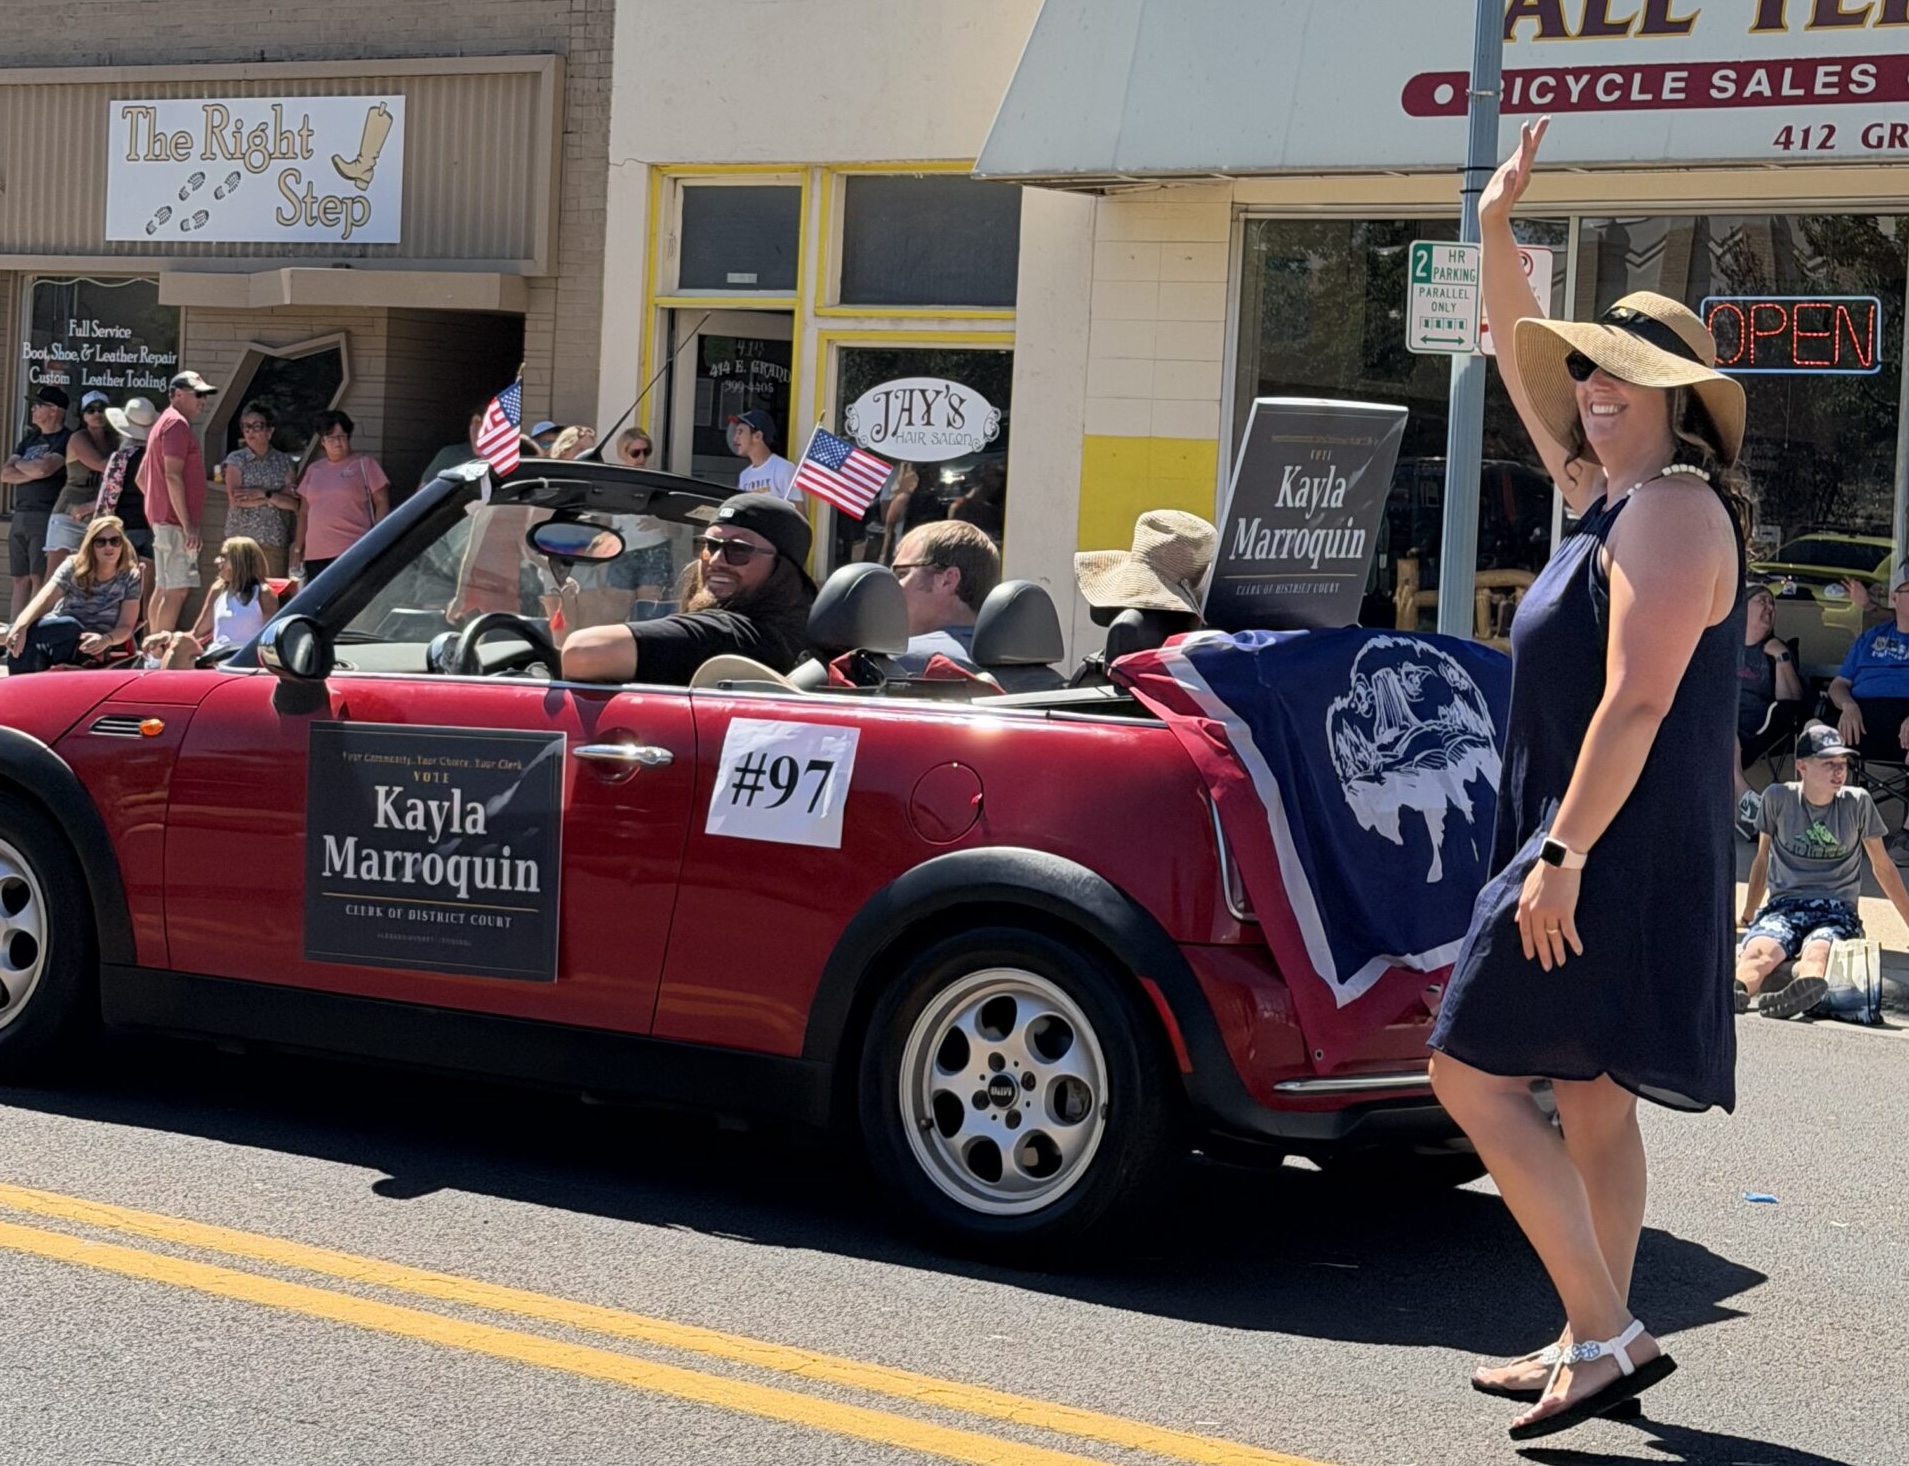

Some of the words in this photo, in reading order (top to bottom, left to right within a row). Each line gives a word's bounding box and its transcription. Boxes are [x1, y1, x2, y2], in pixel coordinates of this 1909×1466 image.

[1499, 70, 1689, 105] ICYCLE
[1709, 63, 1878, 99] SALES
[122, 105, 194, 162] The
[200, 103, 314, 174] Right
[1772, 123, 1837, 150] 412
[276, 167, 371, 240] Step
[1415, 250, 1429, 277] 2
[1448, 250, 1466, 264] HR
[1432, 267, 1476, 282] PARKING
[1419, 287, 1470, 299] PARALLEL
[1431, 302, 1457, 313] ONLY
[69, 319, 91, 337] Full
[91, 319, 132, 338] Service
[1707, 303, 1875, 367] OPEN
[50, 342, 80, 363] Shoe,
[81, 343, 95, 361] &
[95, 344, 138, 363] Leather
[139, 345, 177, 368] Repair
[709, 360, 731, 378] 414
[735, 359, 747, 373] E.
[29, 366, 70, 384] Custom
[81, 368, 125, 387] Leather
[126, 369, 167, 393] Tooling
[870, 384, 967, 443] JAY'S
[896, 431, 927, 445] HAIR
[1275, 464, 1347, 520] Kayla
[1229, 516, 1366, 570] Marroquin
[413, 770, 450, 783] VOTE
[731, 751, 836, 814] #97
[374, 785, 487, 844] Kayla
[321, 834, 541, 899] Marroquin
[345, 904, 384, 917] CLERK
[388, 907, 404, 919] OF
[408, 909, 465, 924] DISTRICT
[470, 914, 512, 928] COURT
